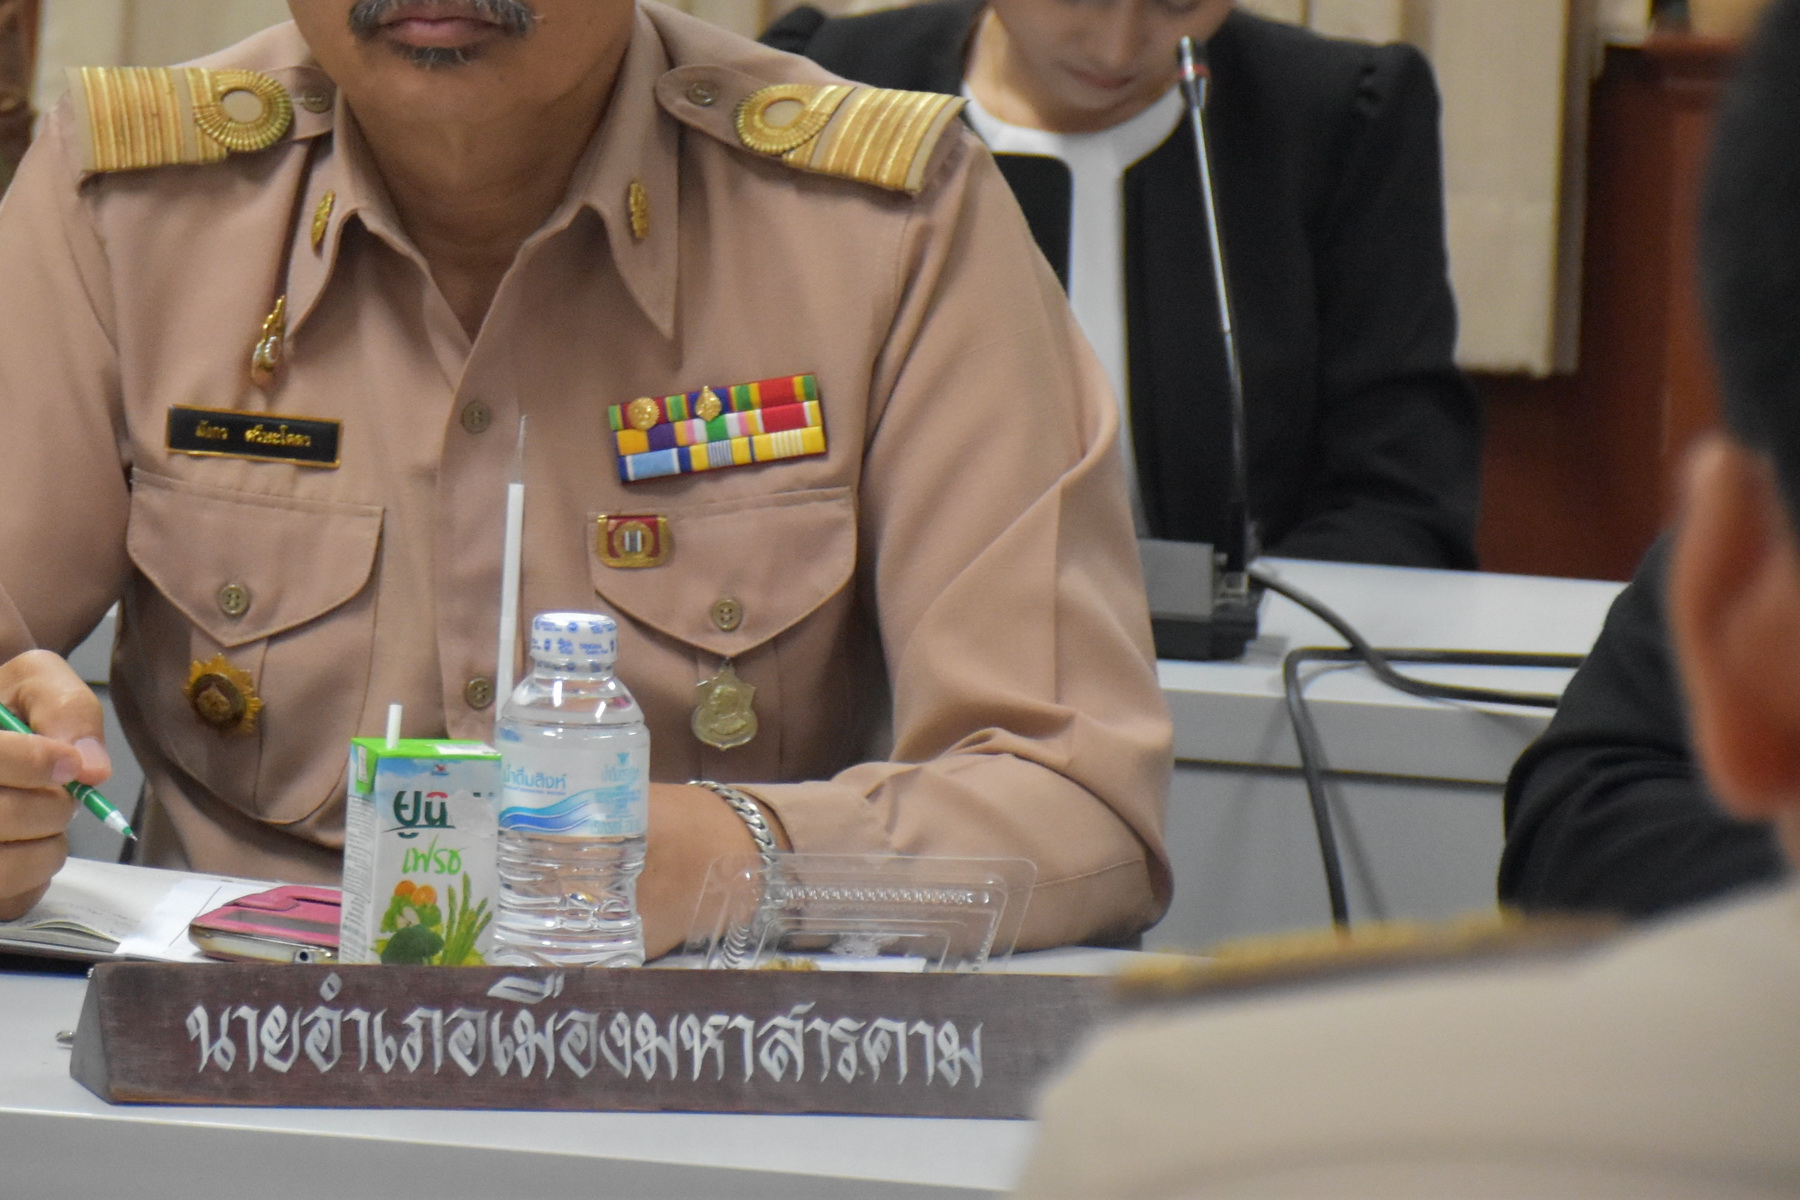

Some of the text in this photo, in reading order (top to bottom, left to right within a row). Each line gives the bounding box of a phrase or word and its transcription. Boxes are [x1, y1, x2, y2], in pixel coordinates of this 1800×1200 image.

[186, 972, 984, 1088] นายอำเภอเมืองมหาสารคาม
